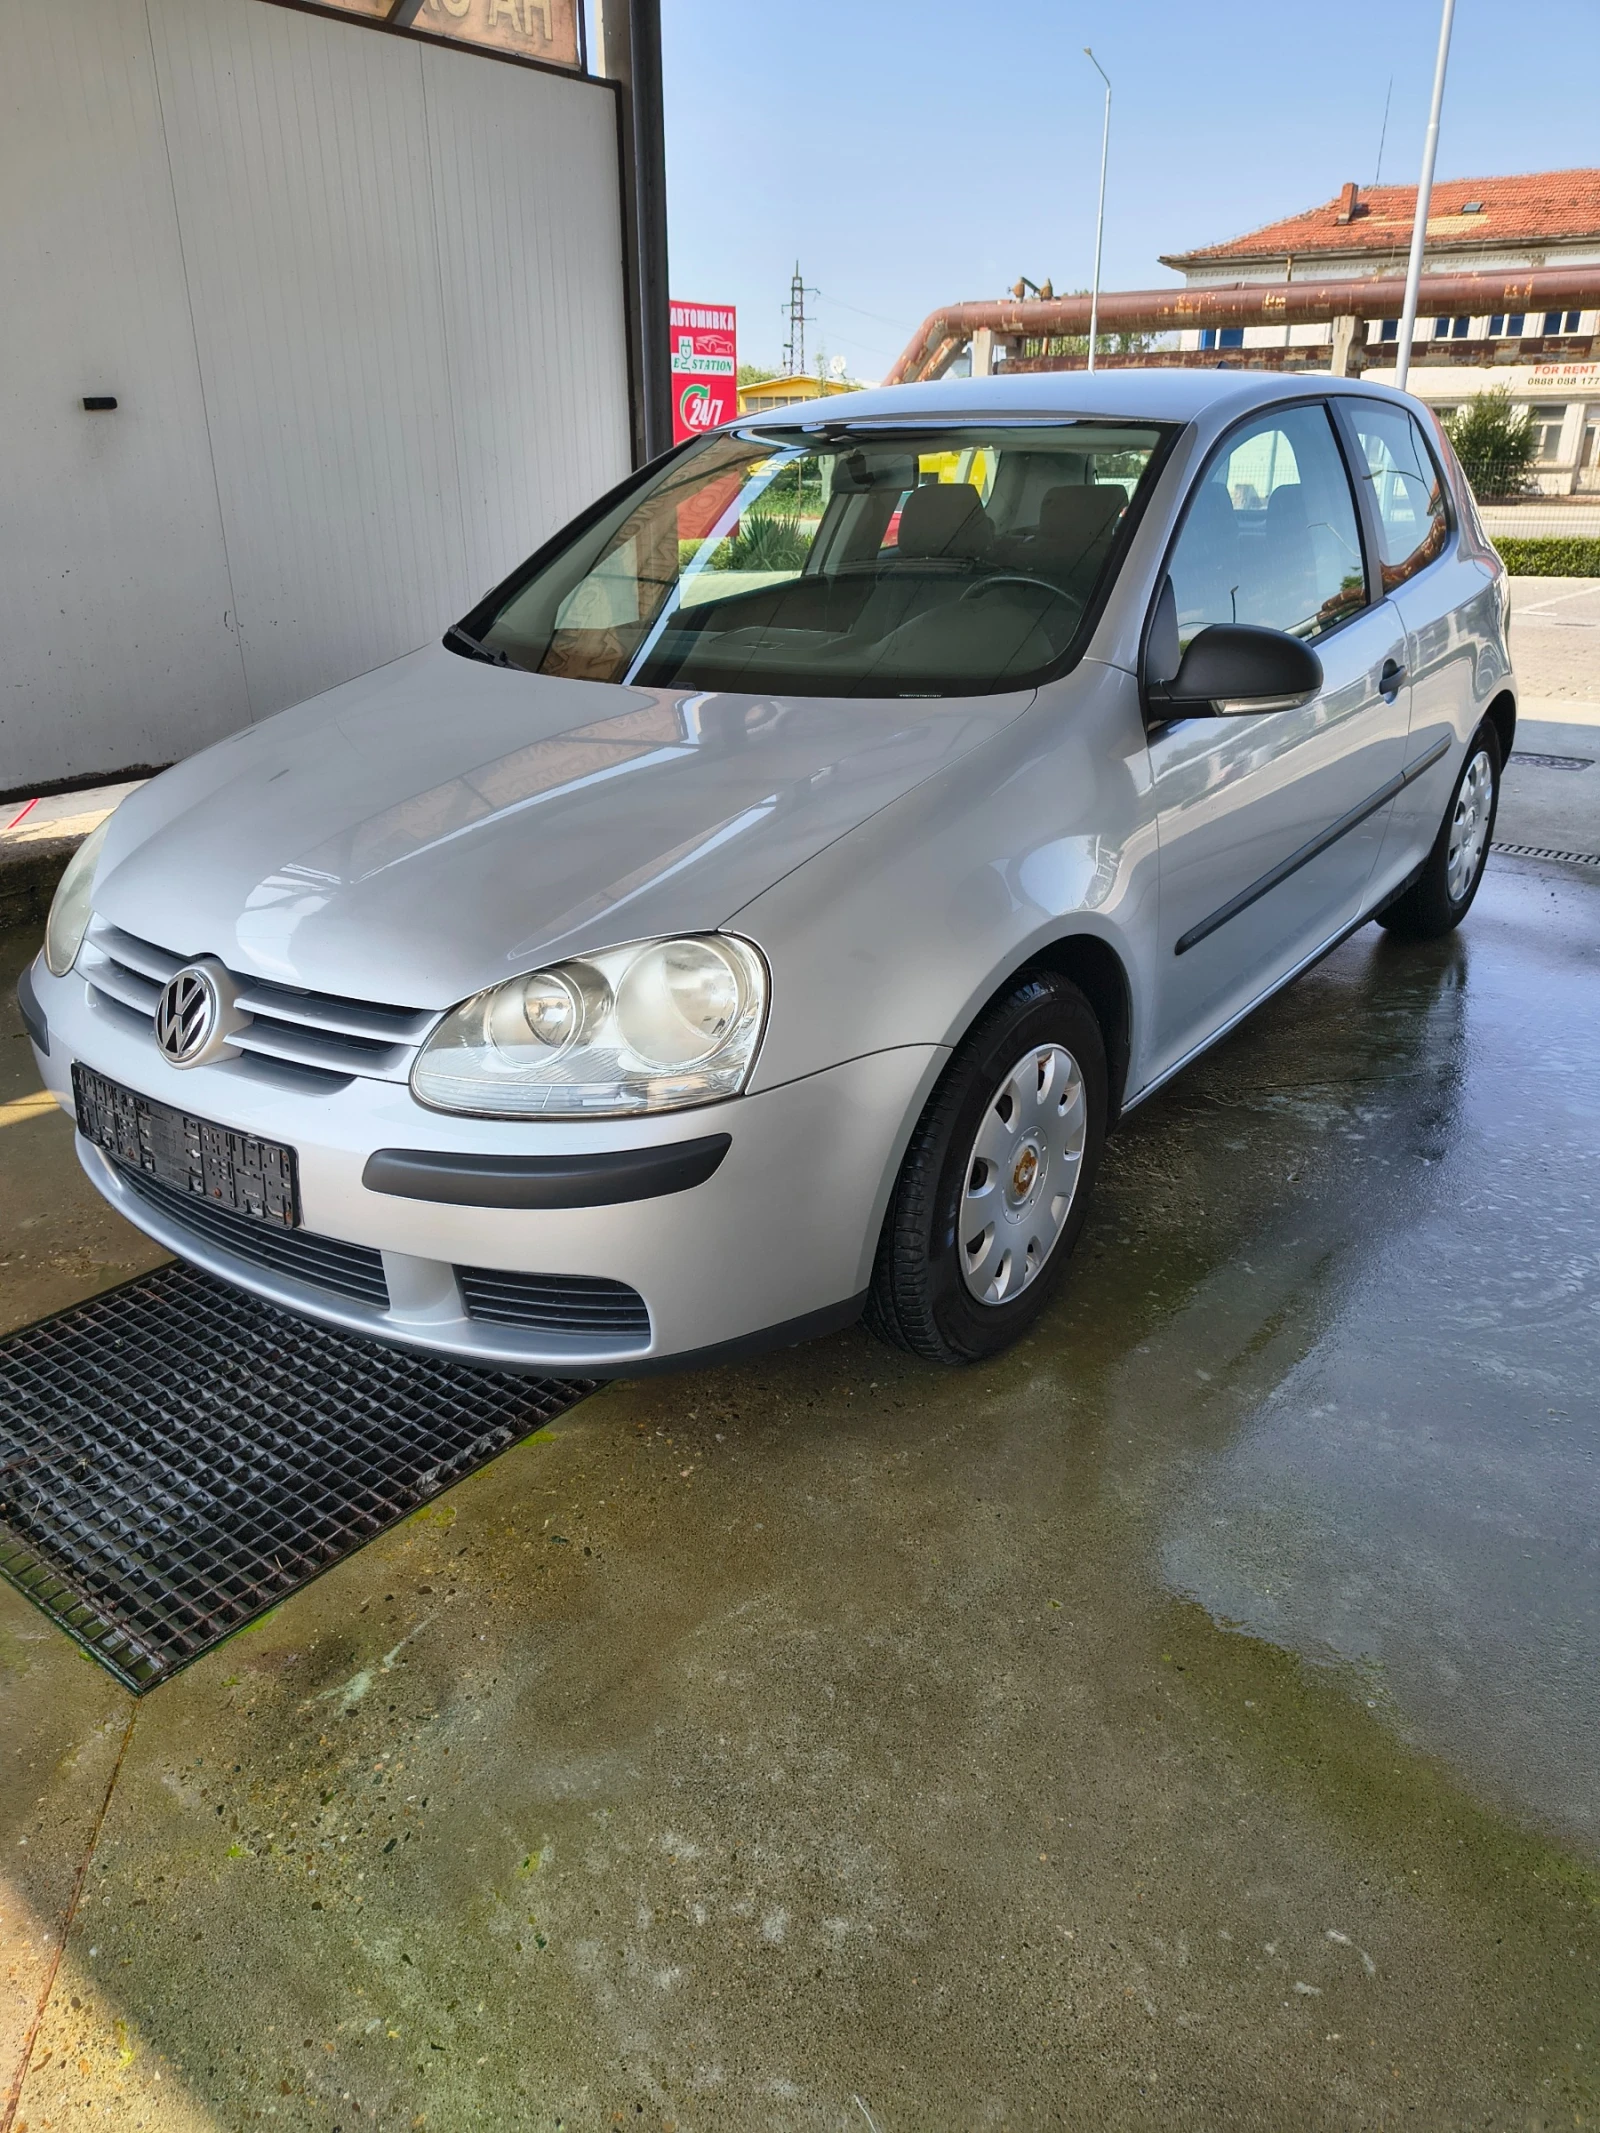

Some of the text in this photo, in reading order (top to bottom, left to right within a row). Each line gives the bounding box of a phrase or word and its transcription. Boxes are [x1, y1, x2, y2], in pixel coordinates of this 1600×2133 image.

[670, 308, 734, 331] АВТОМИВКА
[691, 359, 732, 372] STATION
[1535, 365, 1597, 375] FOR RENT
[1528, 377, 1553, 385] 0888
[690, 399, 724, 426] 24/7
